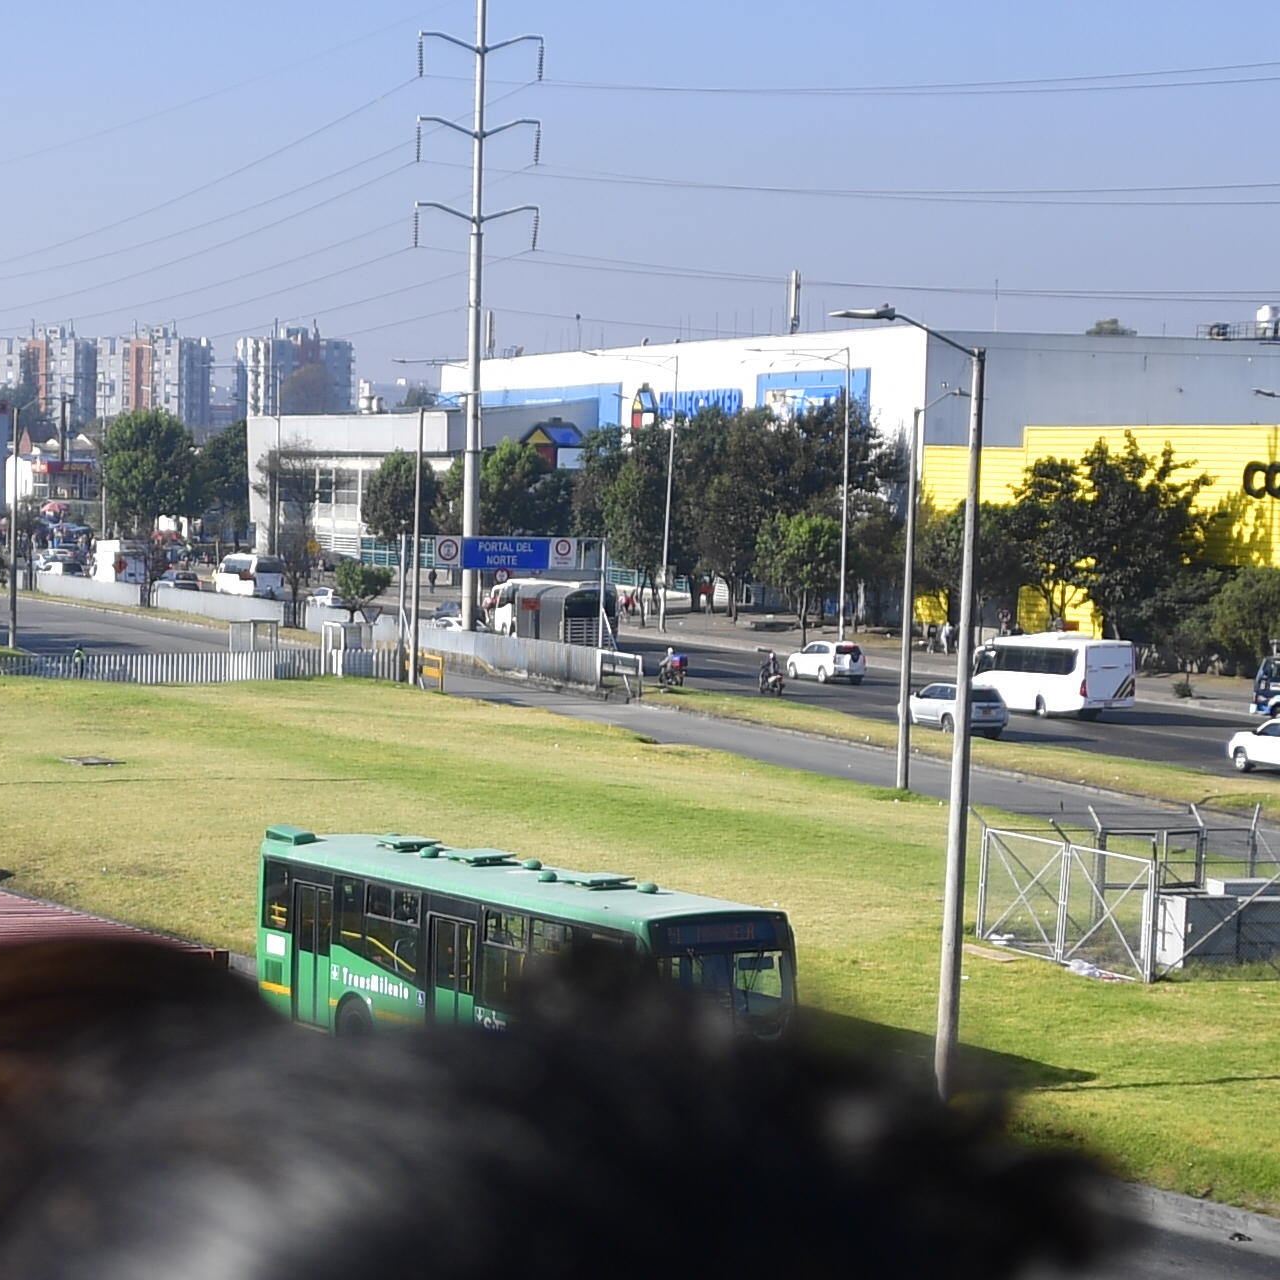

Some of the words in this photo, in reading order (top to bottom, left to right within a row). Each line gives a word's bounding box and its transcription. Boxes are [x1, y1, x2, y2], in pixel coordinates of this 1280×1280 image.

[660, 388, 743, 421] HOMECENTER
[478, 541, 514, 552] PORTAL
[516, 542, 533, 552] DEL
[486, 555, 518, 566] NORTE
[342, 966, 409, 1000] TransMilenio
